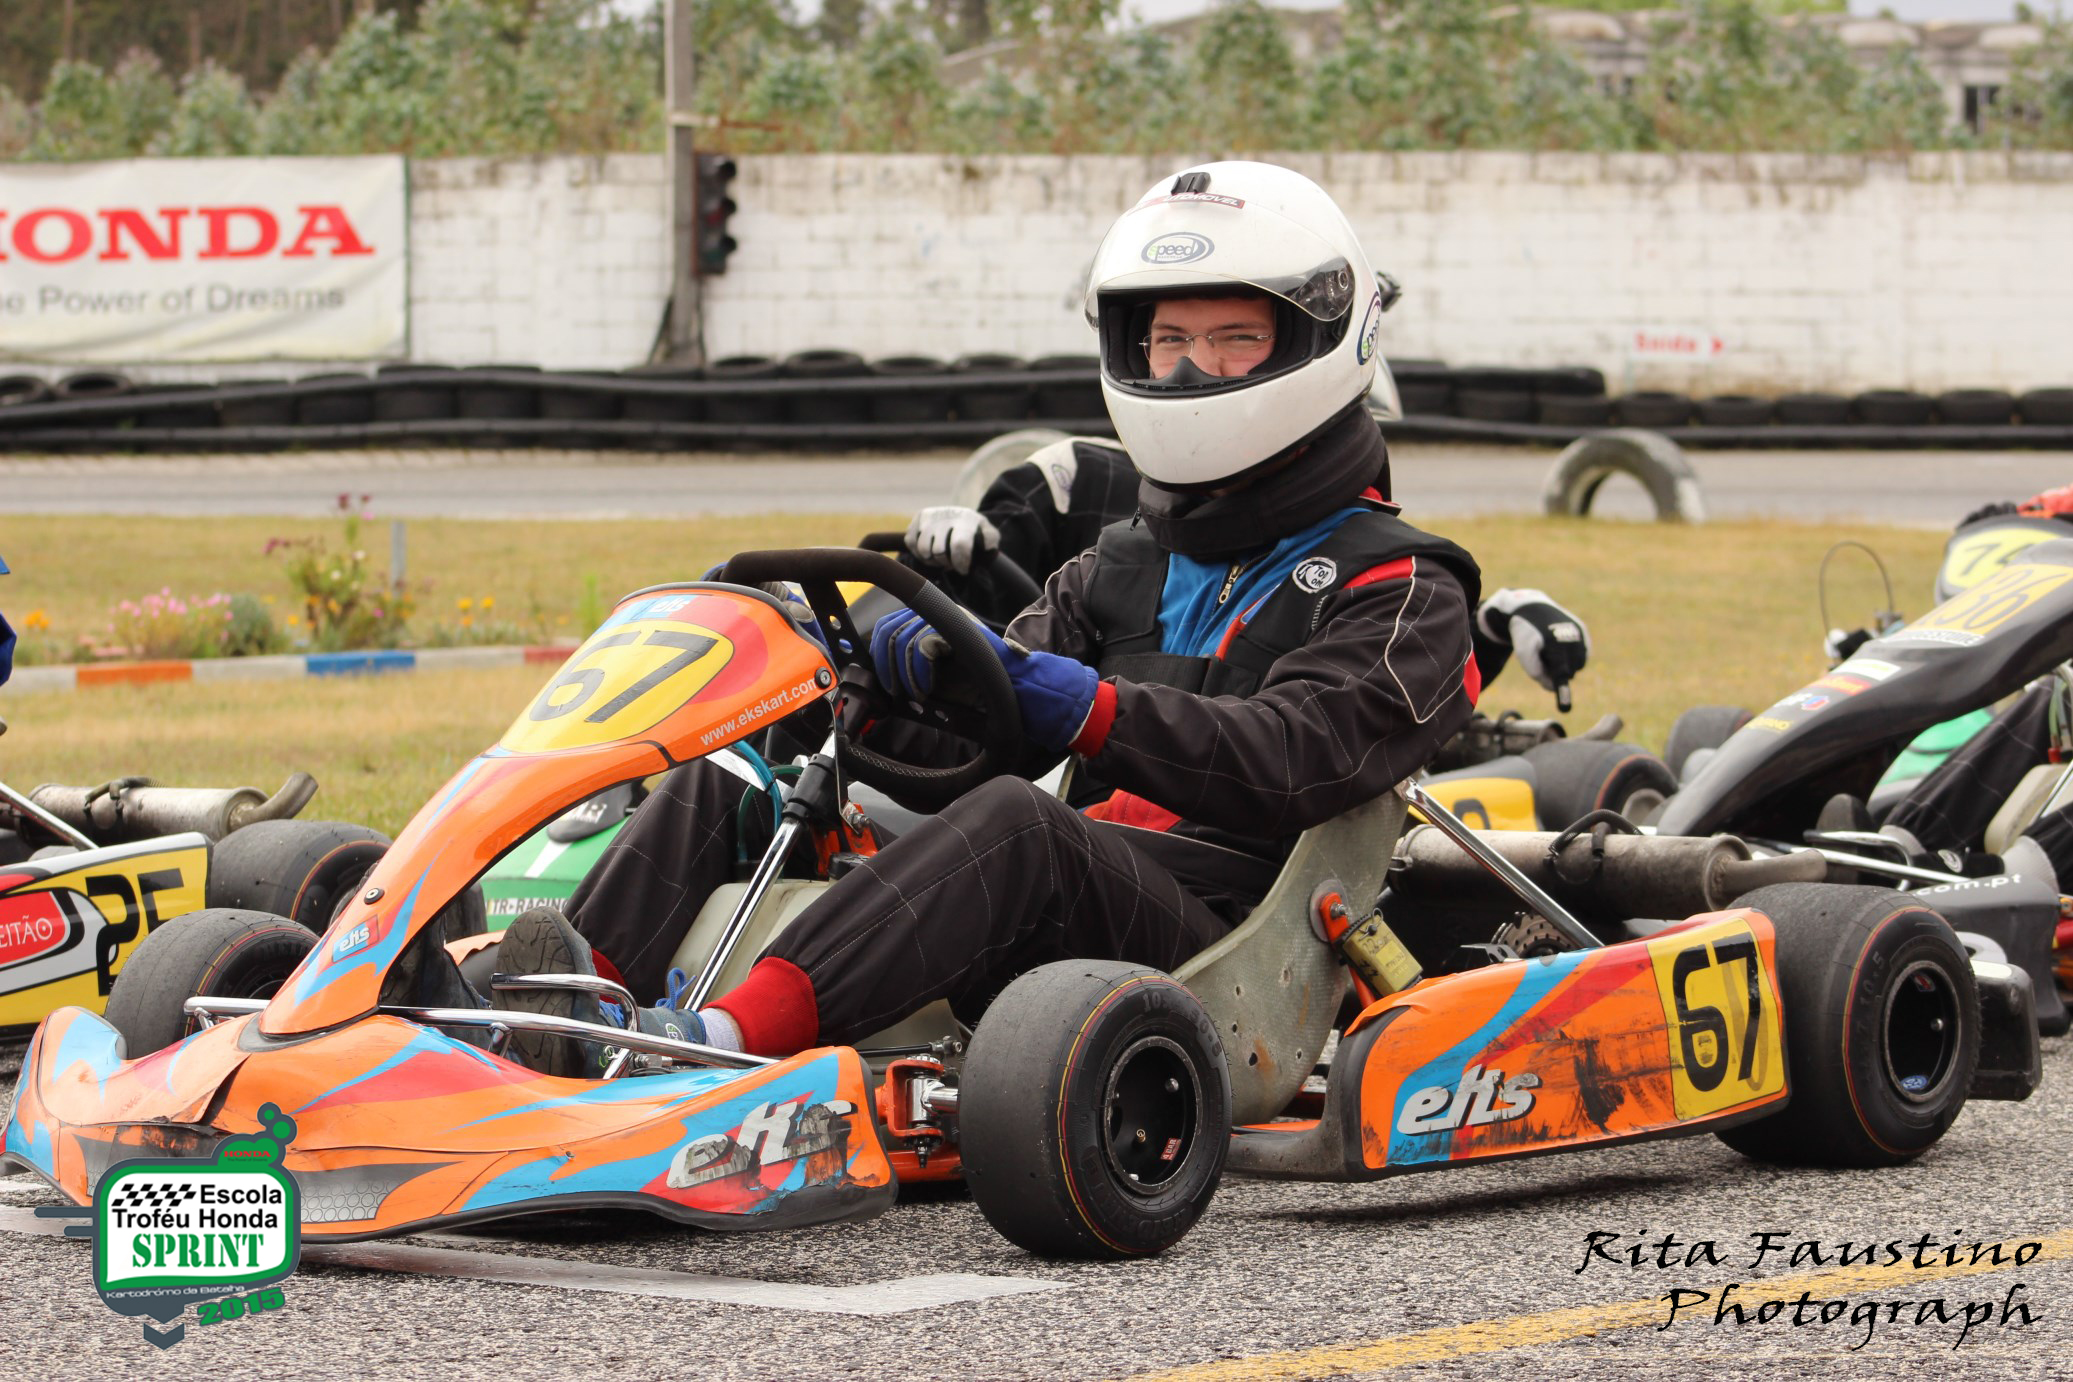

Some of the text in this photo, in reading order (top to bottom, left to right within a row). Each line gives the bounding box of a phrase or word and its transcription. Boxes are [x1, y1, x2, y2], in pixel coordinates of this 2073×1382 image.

[38, 286, 147, 313] Power
[160, 286, 196, 313] of
[207, 284, 345, 313] Dreams
[529, 629, 719, 724] 67
[1672, 931, 1761, 1093] 67
